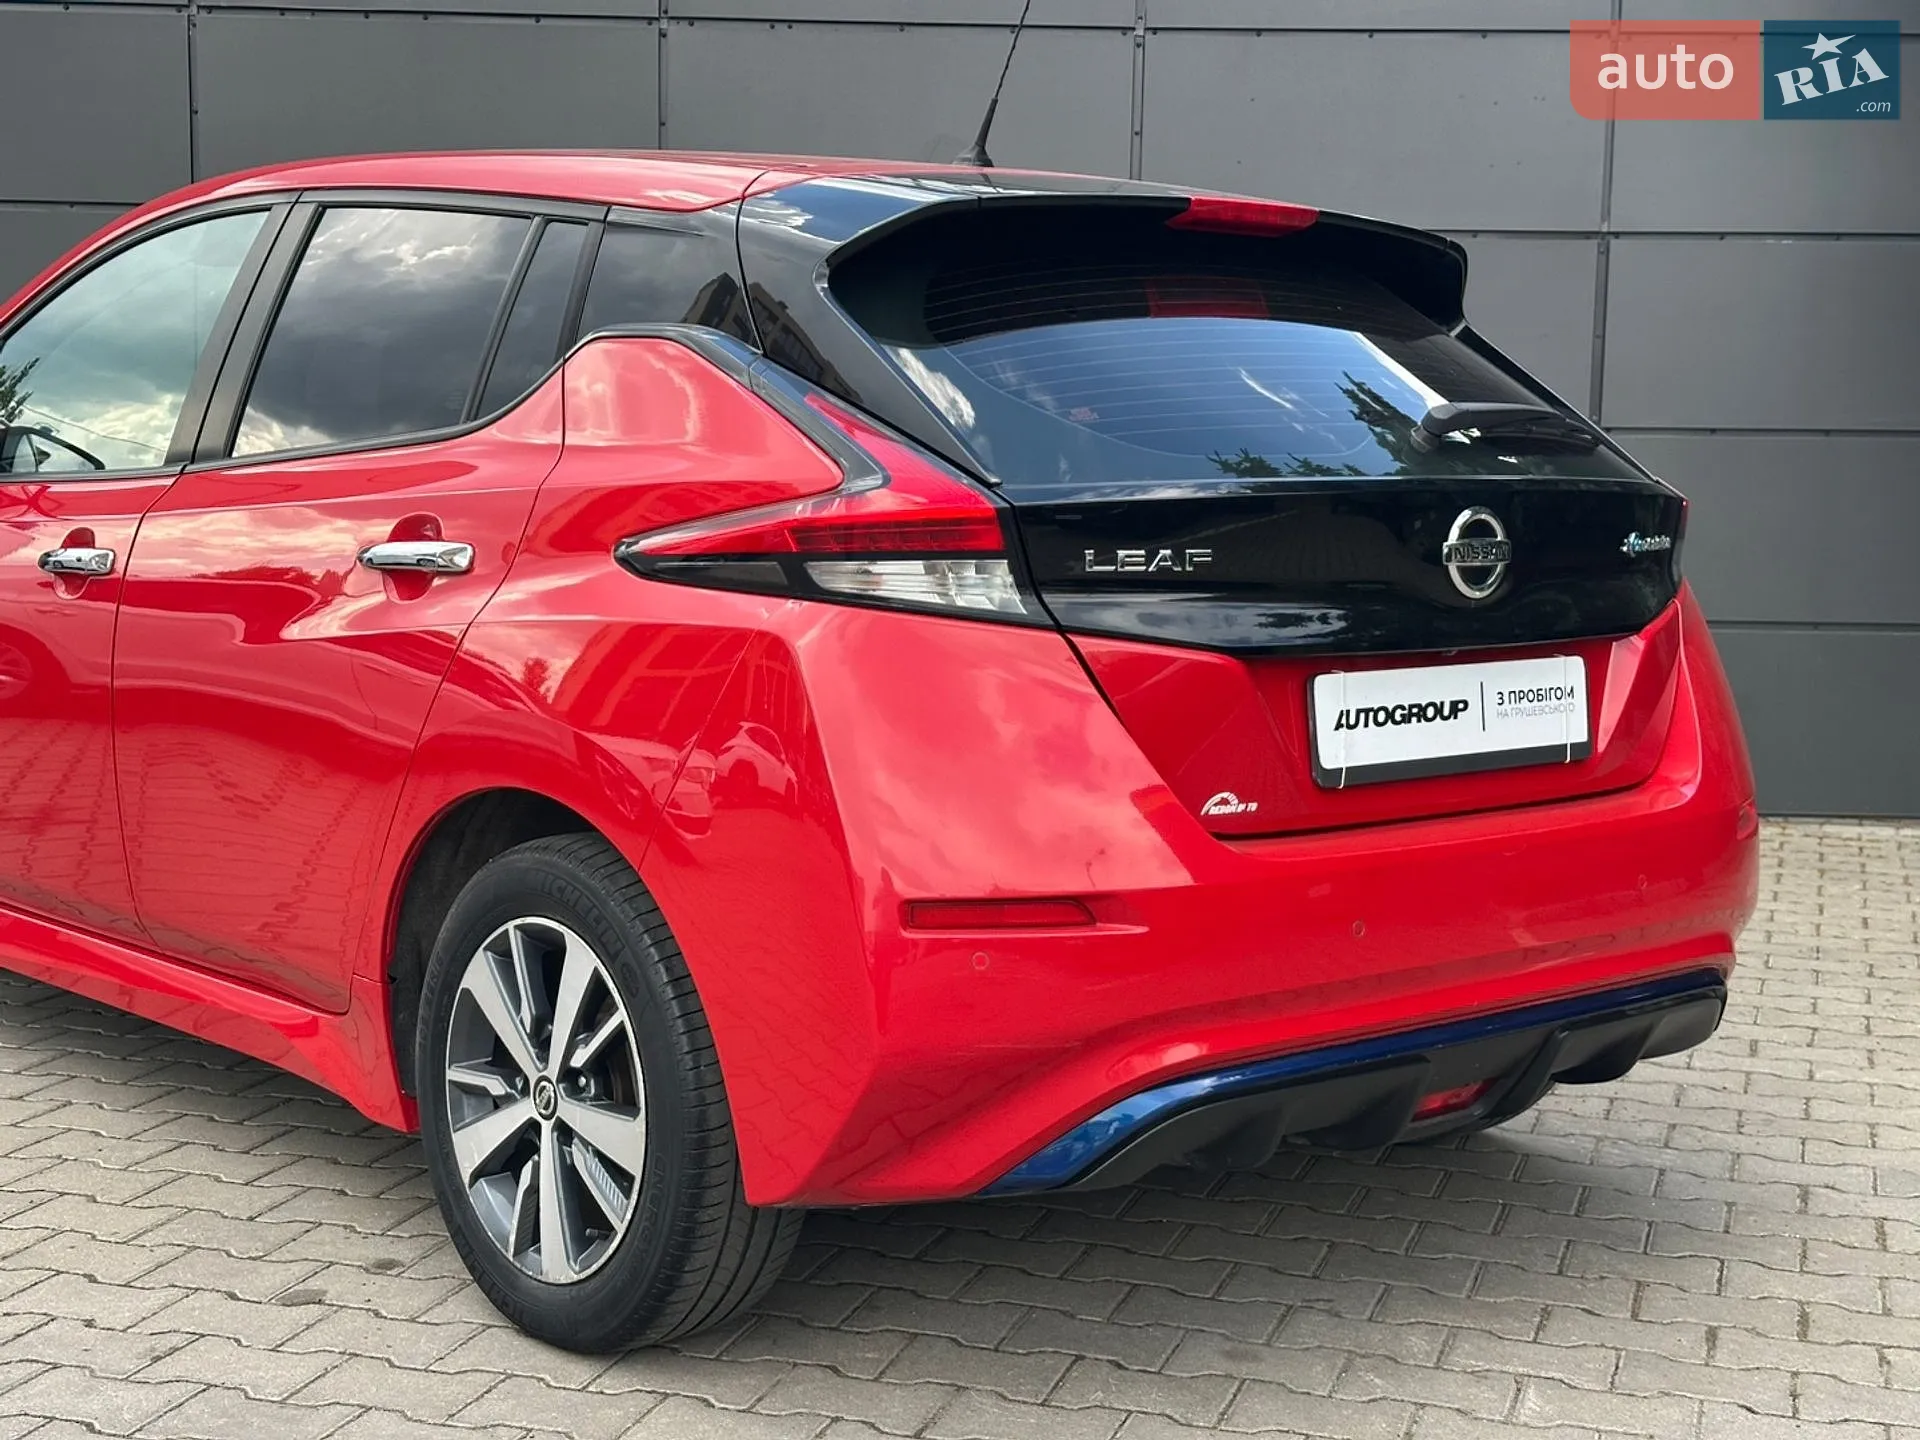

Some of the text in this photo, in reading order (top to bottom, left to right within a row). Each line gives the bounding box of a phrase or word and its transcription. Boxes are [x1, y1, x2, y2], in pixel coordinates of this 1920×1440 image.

[1084, 549, 1212, 572] LEAF
[1446, 543, 1509, 562] NISSAN
[1508, 685, 1575, 704] ПРОБІГОМ
[1333, 699, 1469, 731] AUTOGROUP
[1511, 702, 1576, 717] ГРУШЕВСЬКОО
